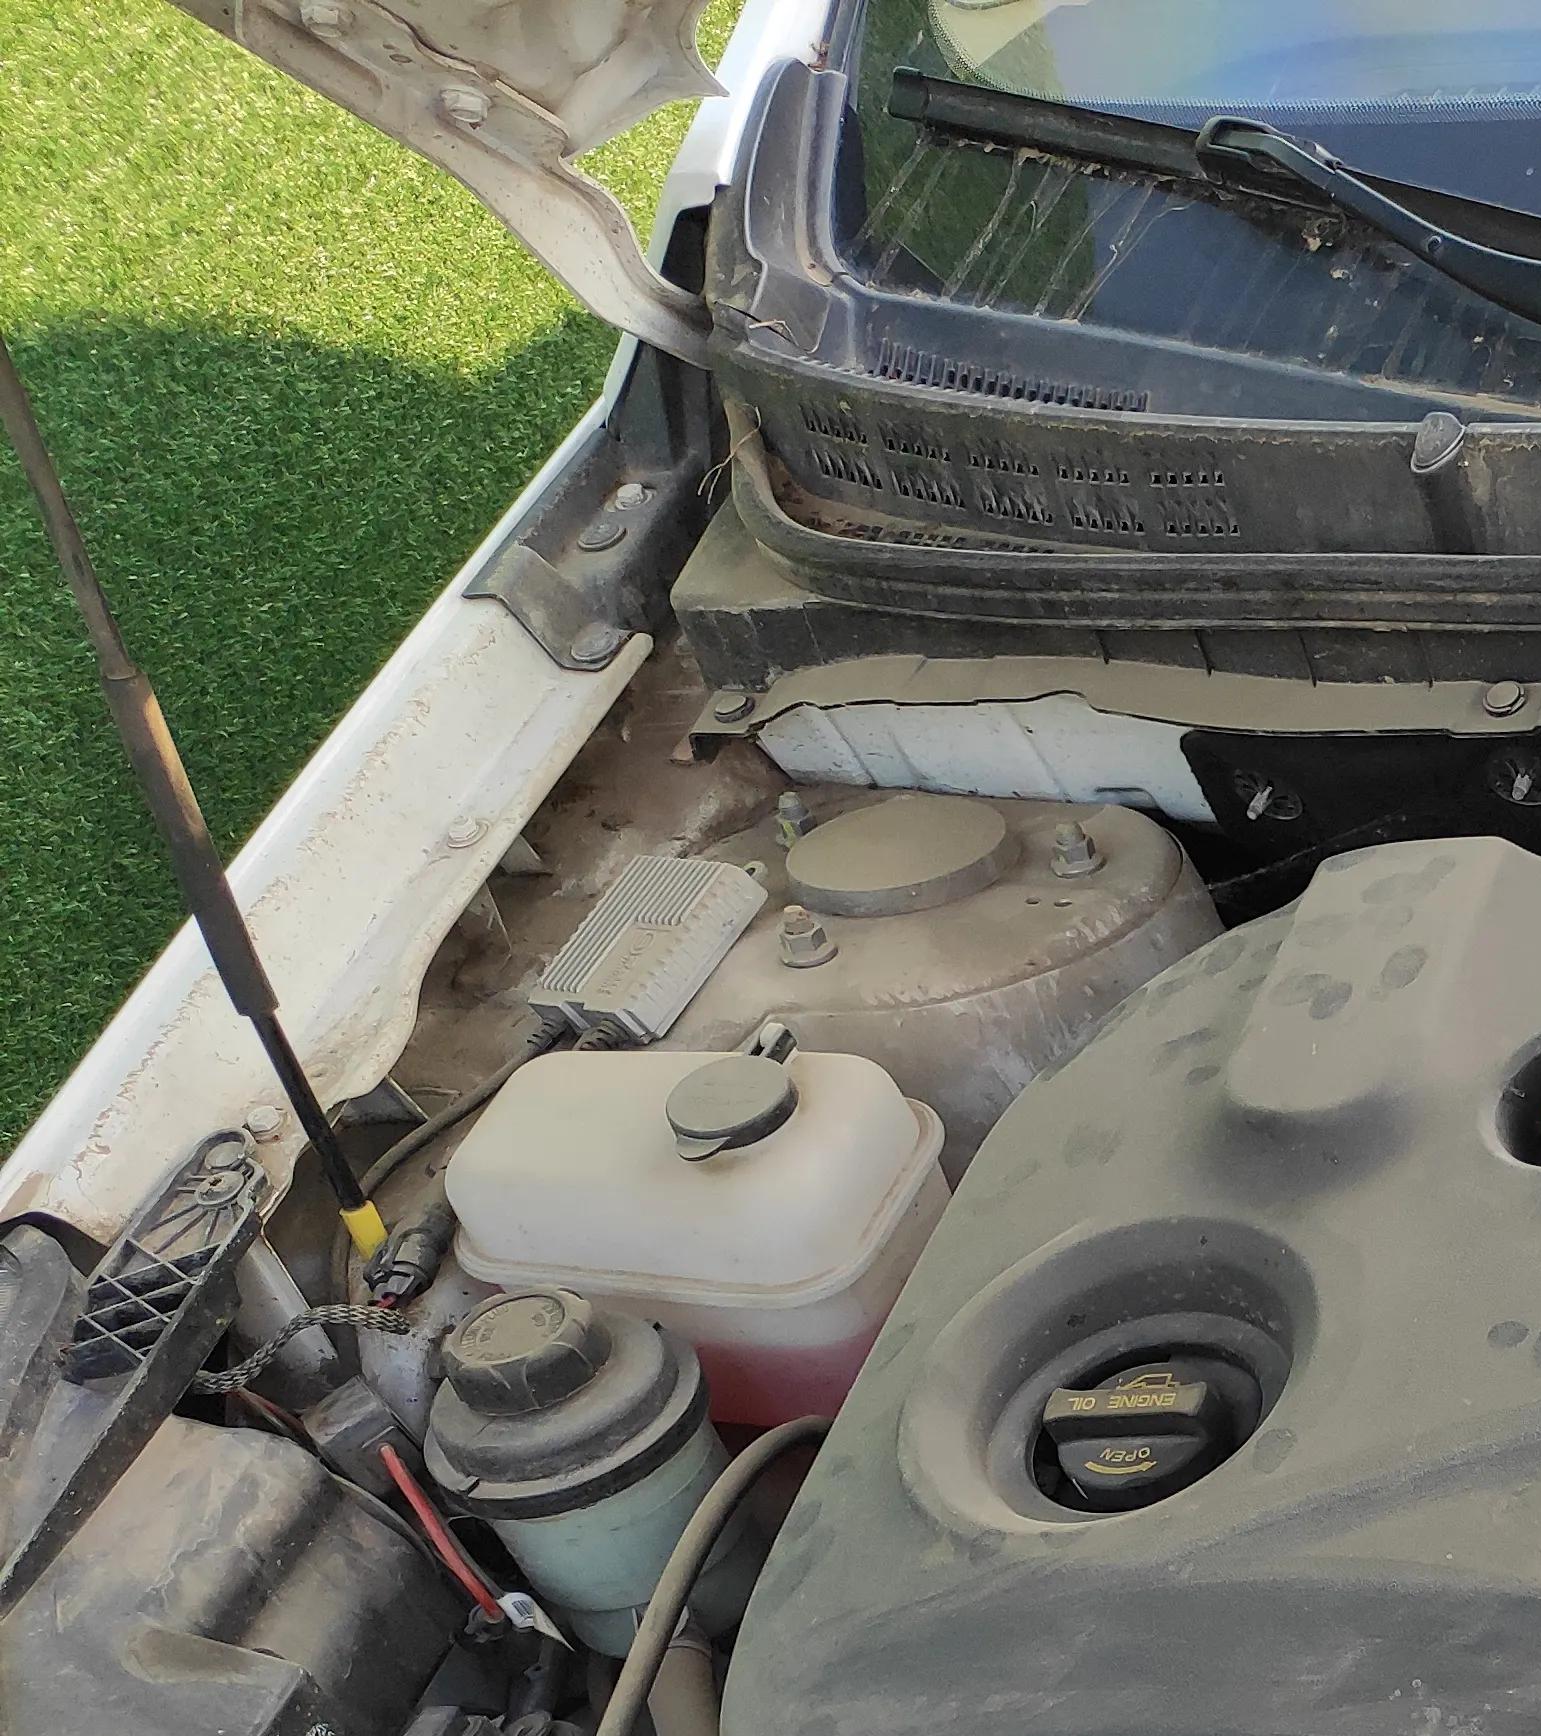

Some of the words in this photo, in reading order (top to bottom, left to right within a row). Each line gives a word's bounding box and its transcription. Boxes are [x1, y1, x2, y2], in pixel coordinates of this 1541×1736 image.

[1067, 1396, 1097, 1411] OIL
[1107, 1392, 1177, 1410] ENGINE
[1099, 1446, 1151, 1463] OPEN
